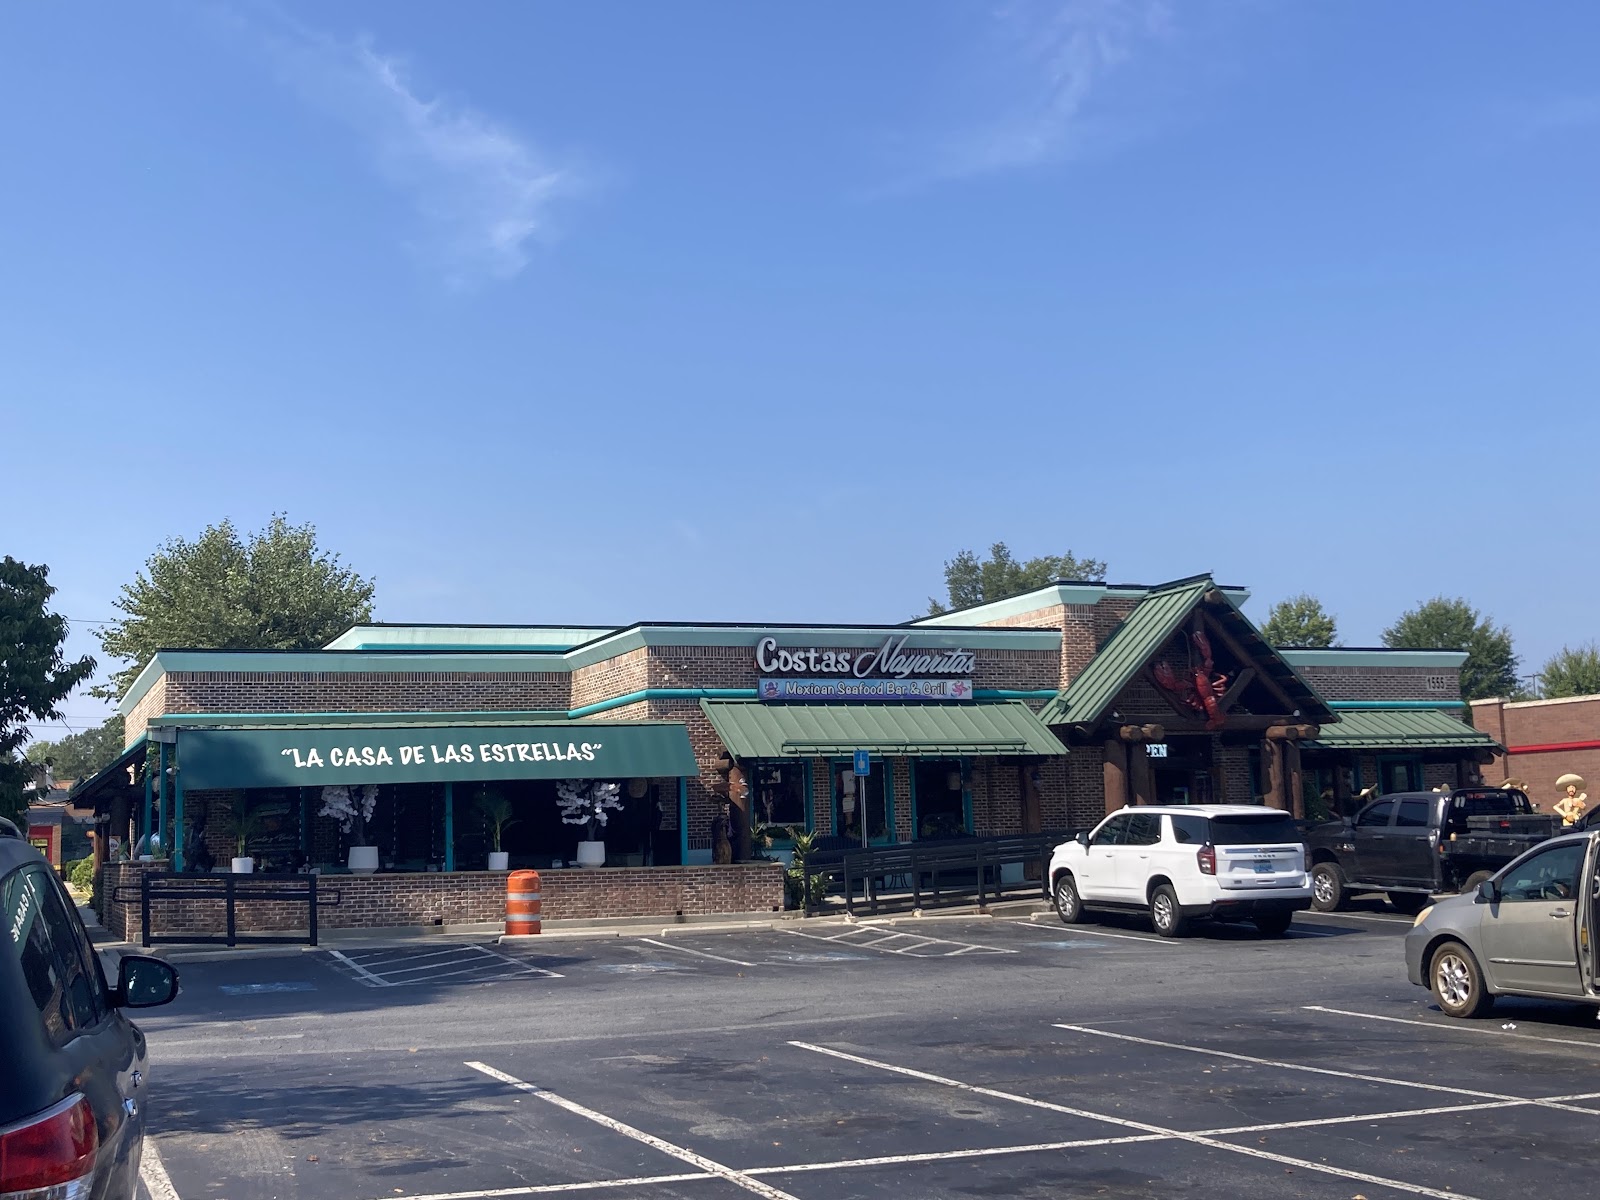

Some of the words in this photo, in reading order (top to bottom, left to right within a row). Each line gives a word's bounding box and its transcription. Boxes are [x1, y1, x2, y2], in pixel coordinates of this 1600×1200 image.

[756, 636, 851, 673] Costas
[852, 634, 976, 679] Nayaritas
[785, 681, 835, 695] Mexican
[837, 681, 884, 695] Seafood
[886, 681, 907, 695] Bar
[910, 681, 921, 695] &
[923, 681, 947, 695] Grill
[330, 746, 393, 767] CASA
[399, 745, 426, 765] DE
[430, 744, 473, 764] LAS
